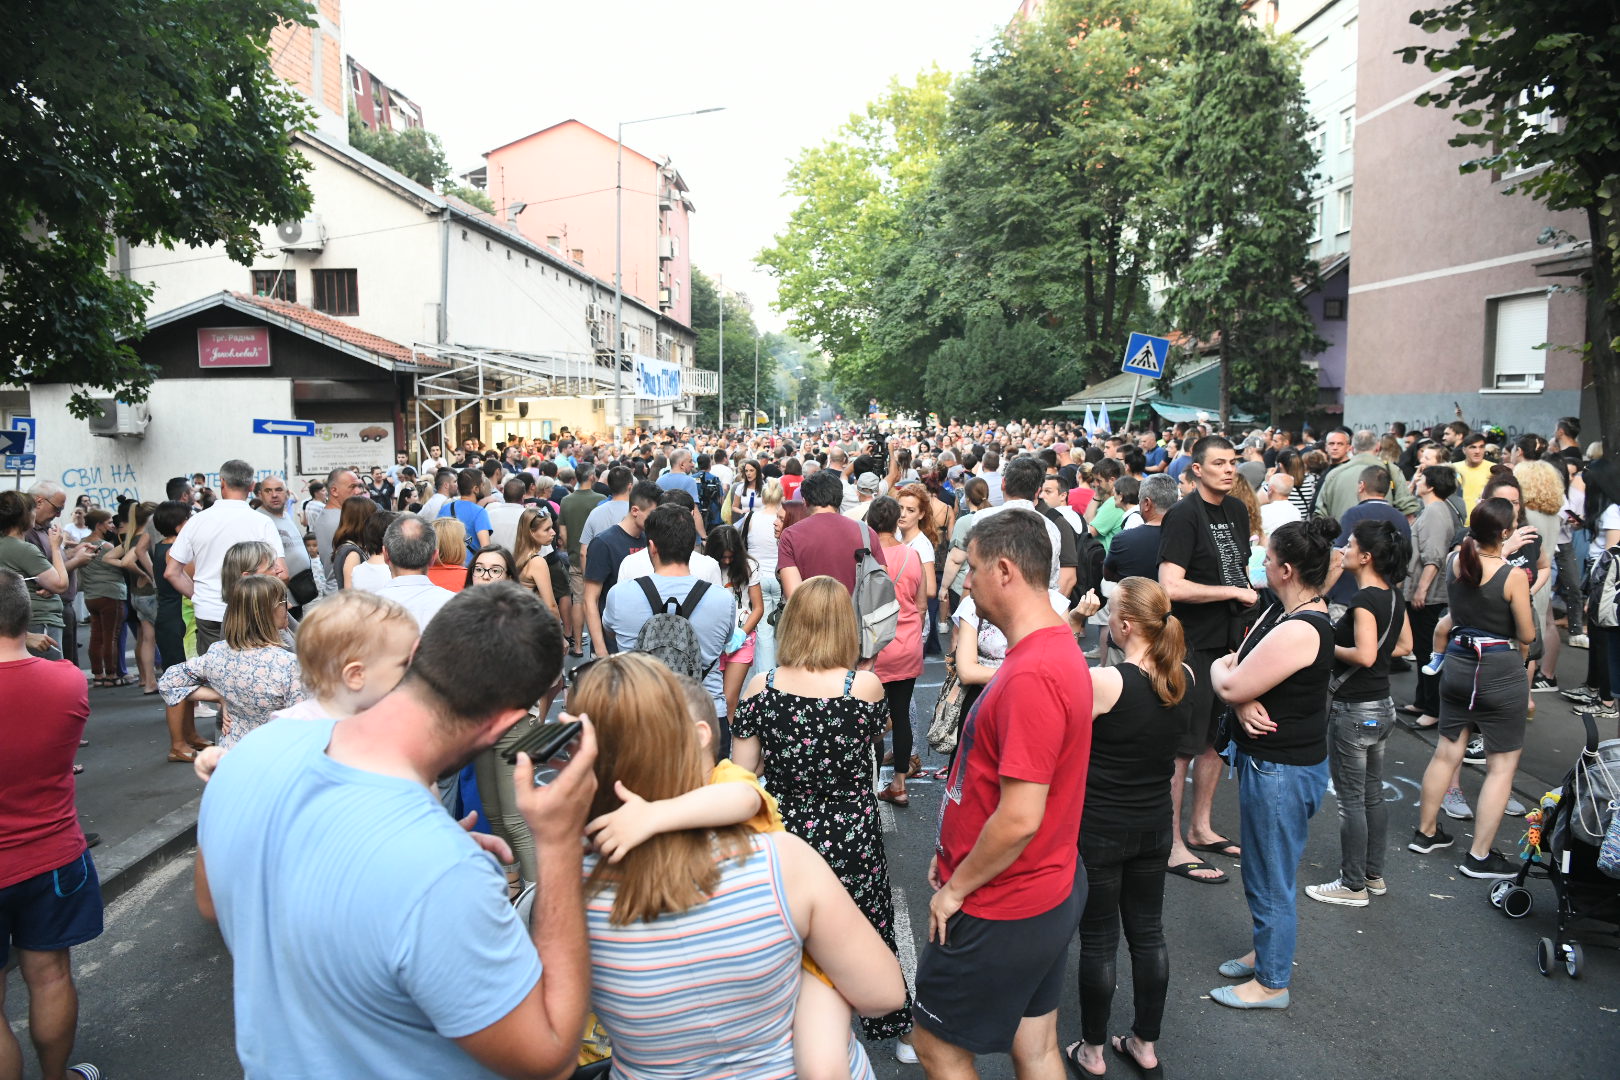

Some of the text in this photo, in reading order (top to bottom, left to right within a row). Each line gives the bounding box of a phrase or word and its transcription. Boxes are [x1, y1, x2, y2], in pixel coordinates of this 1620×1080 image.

[212, 335, 256, 343] Трг. Радња
[62, 463, 137, 487] СВИ НА
